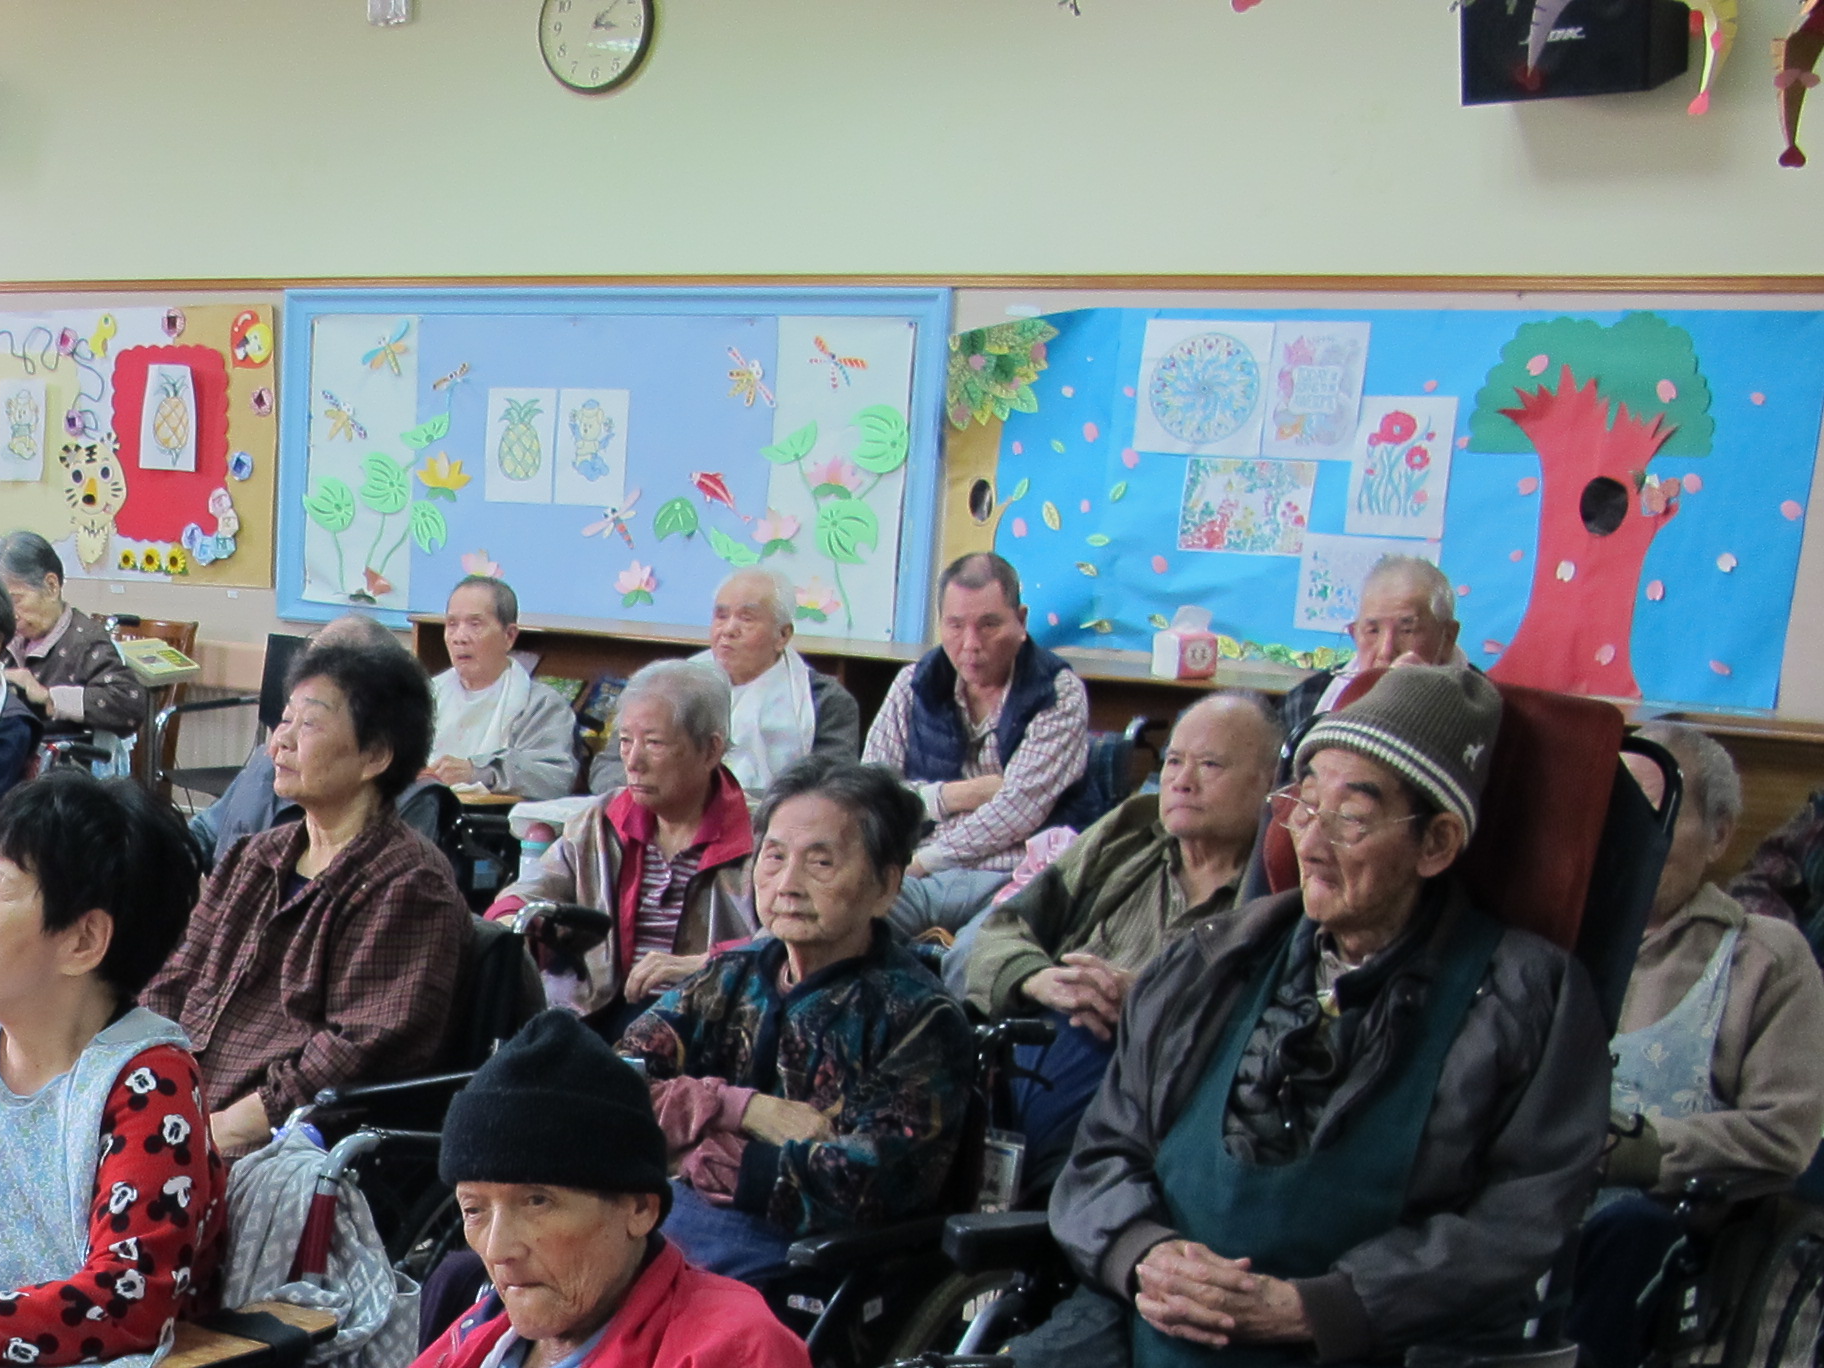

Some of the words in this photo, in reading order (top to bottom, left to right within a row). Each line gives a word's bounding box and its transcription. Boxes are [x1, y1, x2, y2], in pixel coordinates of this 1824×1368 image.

[553, 21, 563, 36] 9
[557, 43, 567, 58] 8
[570, 60, 578, 74] 7
[610, 57, 621, 72] 5
[590, 66, 600, 81] 6
